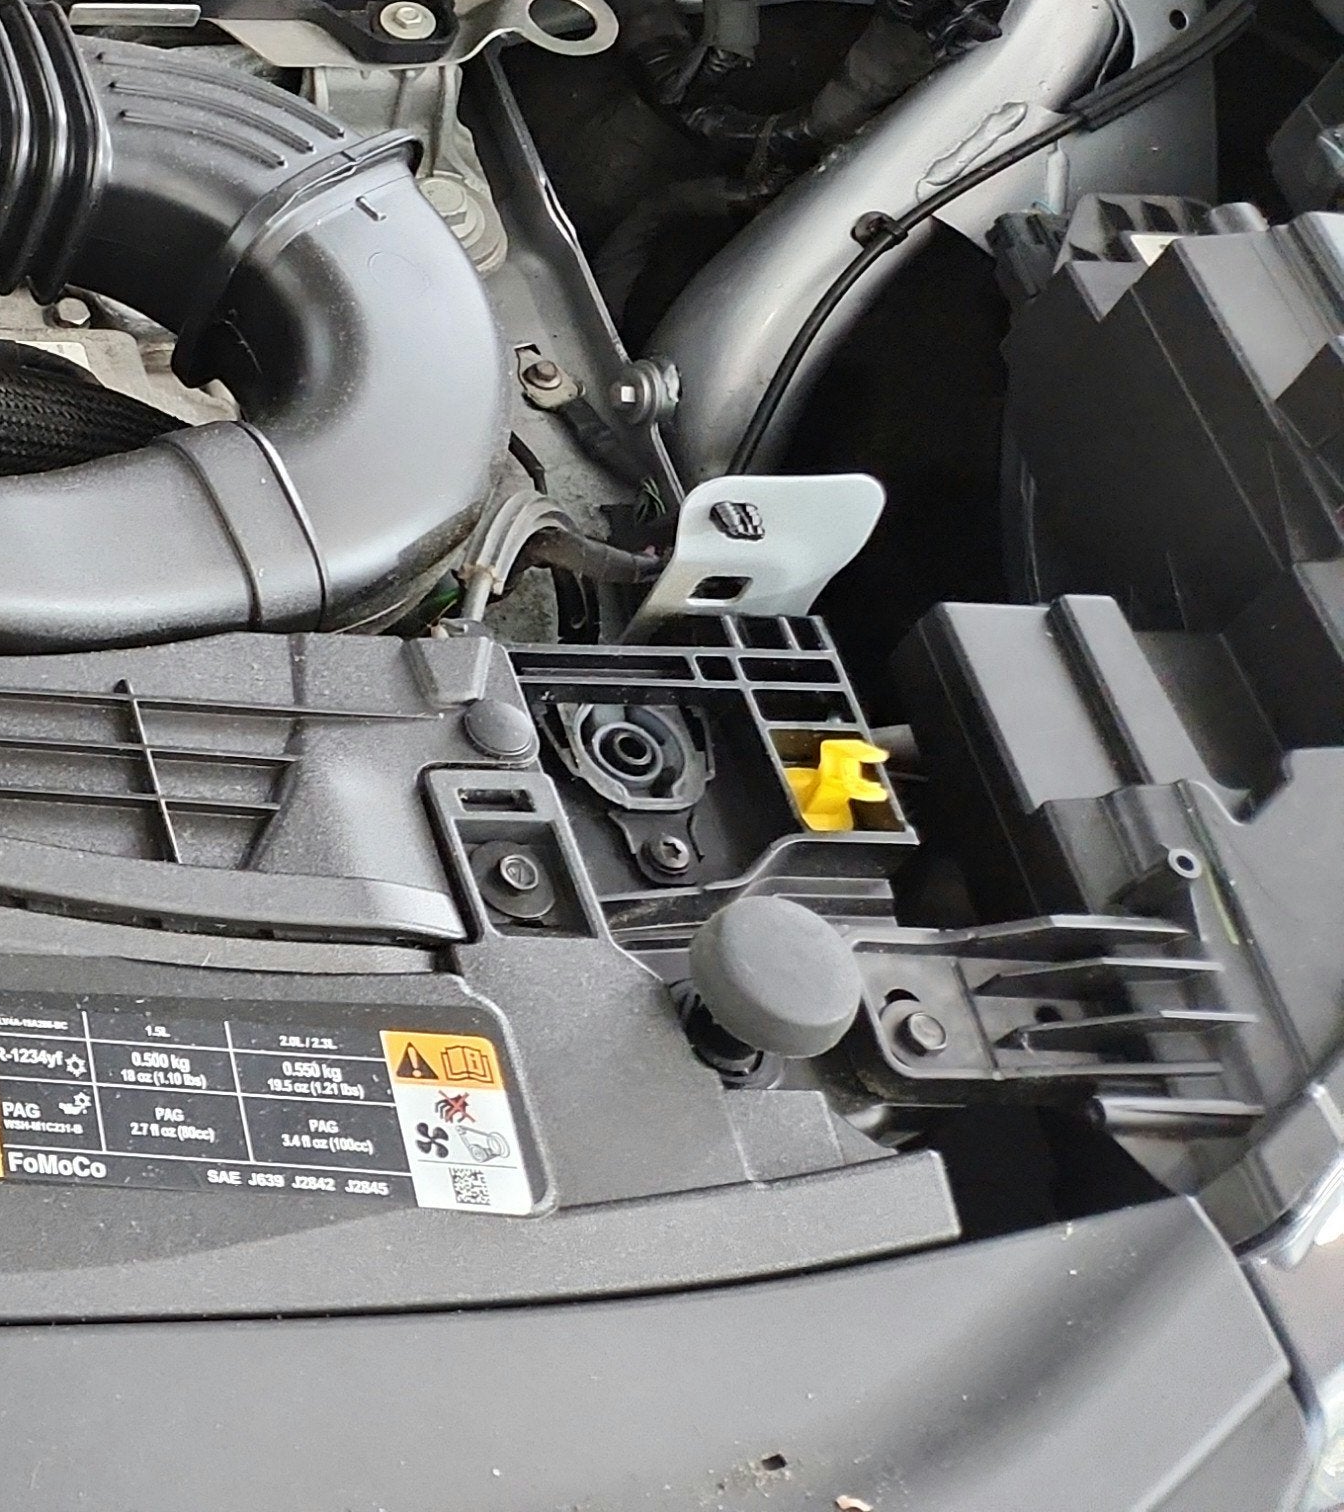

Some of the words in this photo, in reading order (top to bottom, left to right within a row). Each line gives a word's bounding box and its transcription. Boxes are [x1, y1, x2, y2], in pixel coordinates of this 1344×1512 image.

[145, 1025, 171, 1038] 1.5L
[131, 1052, 169, 1069] 0.500
[171, 1055, 190, 1073] kg
[282, 1061, 320, 1078] 0.550
[322, 1063, 343, 1082] kg
[120, 1068, 135, 1082] 18
[137, 1072, 153, 1083] oz
[154, 1070, 182, 1087] (1.10
[183, 1073, 207, 1090] lbs)
[267, 1078, 293, 1092] 19.5
[294, 1082, 310, 1093] oz
[311, 1080, 339, 1097] (1.21
[341, 1082, 365, 1100] lbs)
[2, 1101, 41, 1119] PAG
[154, 1107, 185, 1122] PAG
[130, 1122, 149, 1137] 2.7
[150, 1123, 160, 1137] fl
[161, 1127, 178, 1138] oz
[308, 1119, 339, 1134] PAG
[281, 1134, 301, 1148] 3.4
[302, 1134, 311, 1148] fl
[312, 1138, 329, 1149] oz
[7, 1151, 107, 1179] FoMoCo
[207, 1169, 243, 1185] SAE
[248, 1172, 286, 1188] J639
[344, 1179, 390, 1196] J2845
